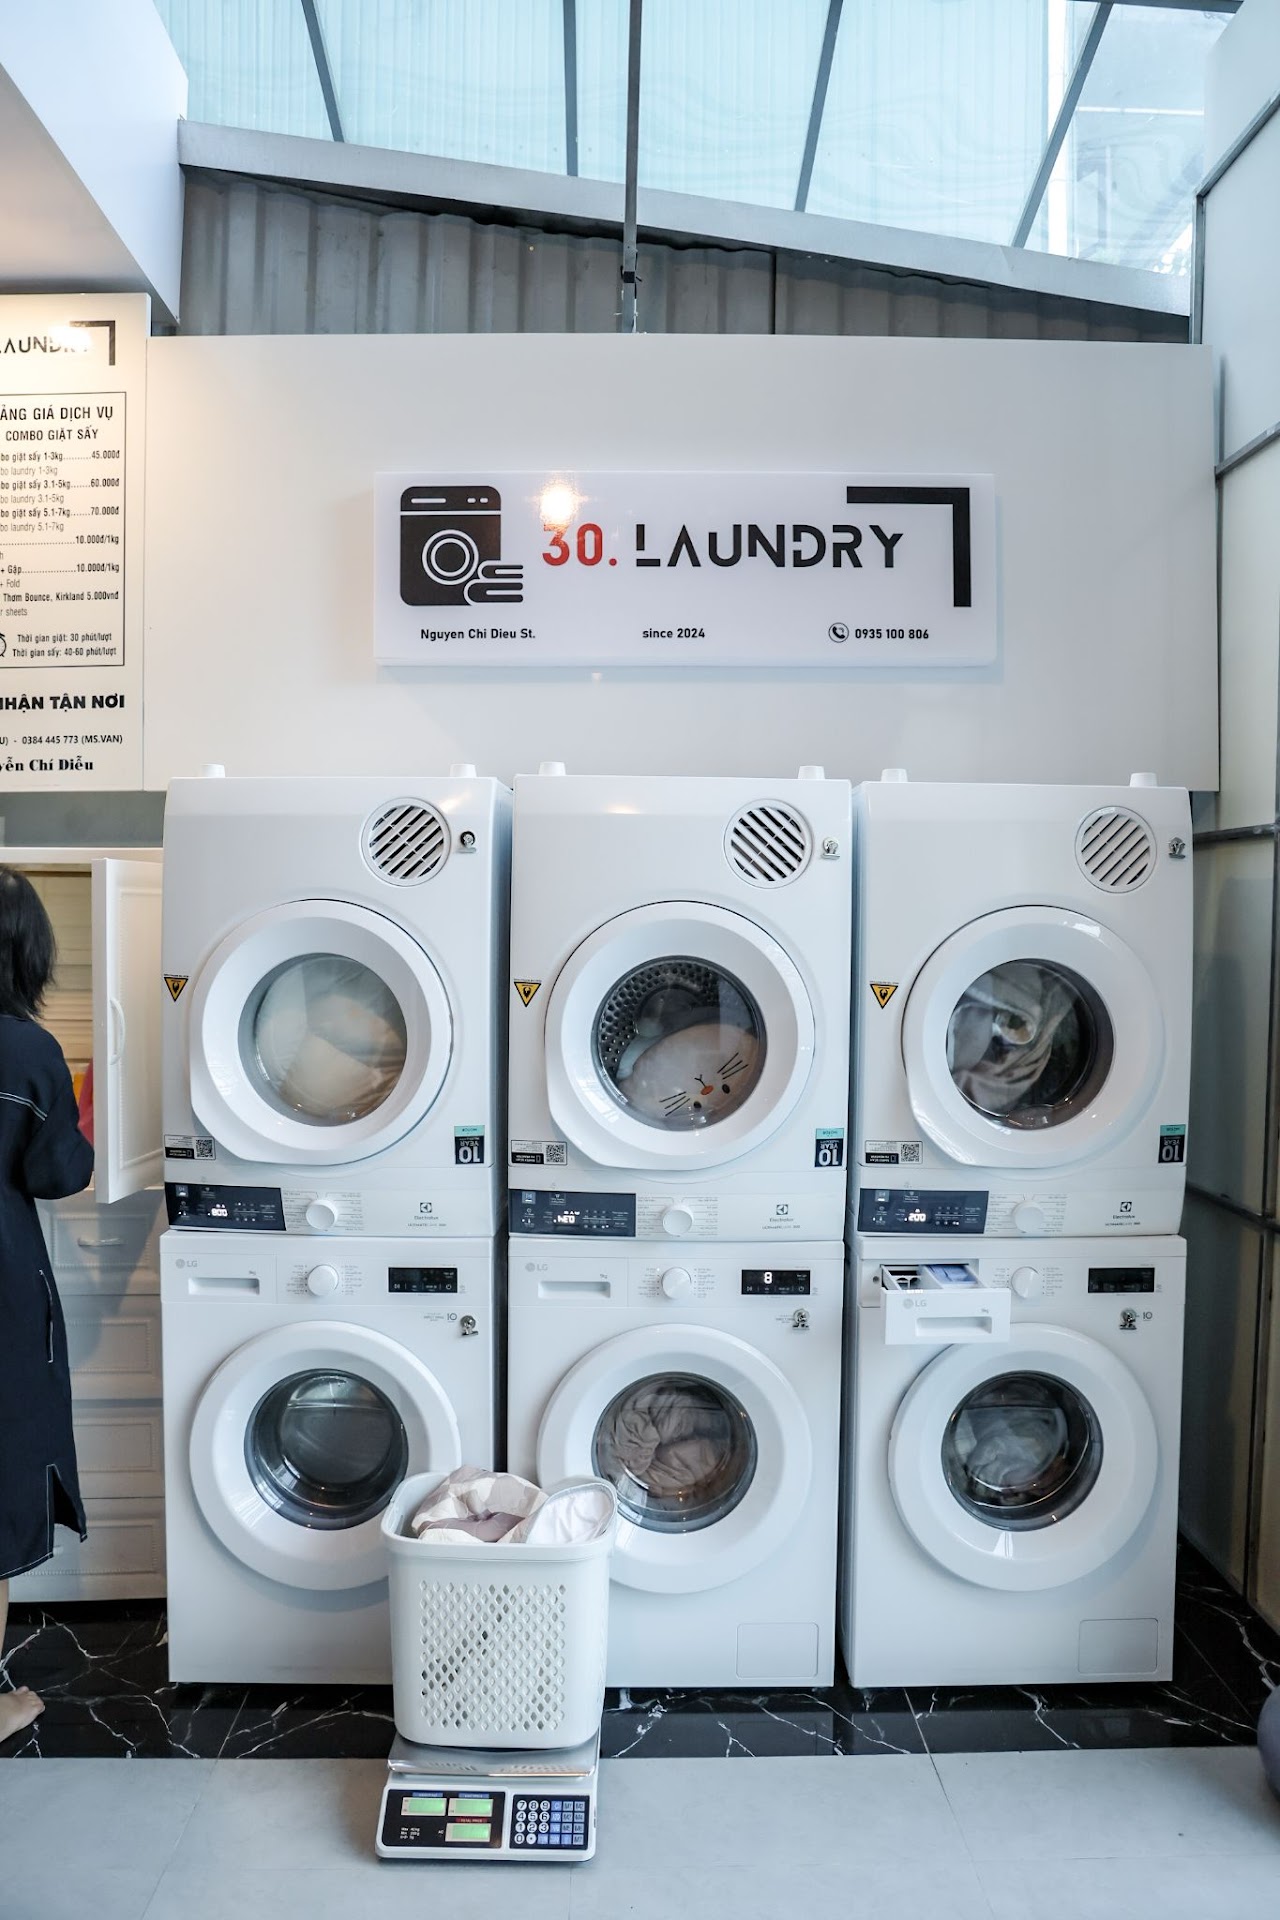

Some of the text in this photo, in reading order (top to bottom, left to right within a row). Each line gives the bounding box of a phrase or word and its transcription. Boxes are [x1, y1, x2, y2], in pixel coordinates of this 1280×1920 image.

[0, 336, 87, 353] AUND
[33, 404, 54, 420] GIÁ
[60, 406, 91, 421] DỊCH
[96, 406, 113, 420] VỤ
[5, 424, 98, 442] COMBO GIẶT SẤY
[10, 466, 36, 477] laundry
[39, 466, 58, 476] 1-3kg
[10, 494, 36, 505] laundry
[37, 494, 64, 504] 3.1-5kg
[10, 522, 36, 533] laundry
[37, 522, 64, 532] 5.1-7kg
[542, 522, 904, 568] 30. LAUNDRY
[6, 578, 20, 588] Fold
[55, 591, 84, 601] Kirkland
[5, 607, 28, 616] sheets
[35, 634, 50, 644] gian
[70, 633, 79, 642] 30
[420, 628, 536, 641] Nguyen Chi Dieu St.
[642, 628, 705, 638] since 2024
[855, 629, 929, 639] 0935 100 806
[30, 648, 45, 658] gian
[64, 647, 84, 656] 40-60
[0, 693, 125, 713] HẬN TẬN NƠI
[22, 736, 42, 744] 0384
[45, 735, 60, 744] 445
[63, 735, 78, 744] 773
[81, 734, 123, 745] (MS.VAN)
[29, 758, 53, 771] Chí
[458, 1146, 481, 1163] 10
[818, 1149, 839, 1166] 10
[1161, 1145, 1180, 1161] 10
[186, 1260, 198, 1268] LG
[763, 1271, 773, 1284] 8
[915, 1299, 927, 1307] LG
[519, 1801, 525, 1809] 7
[518, 1812, 524, 1820] 4
